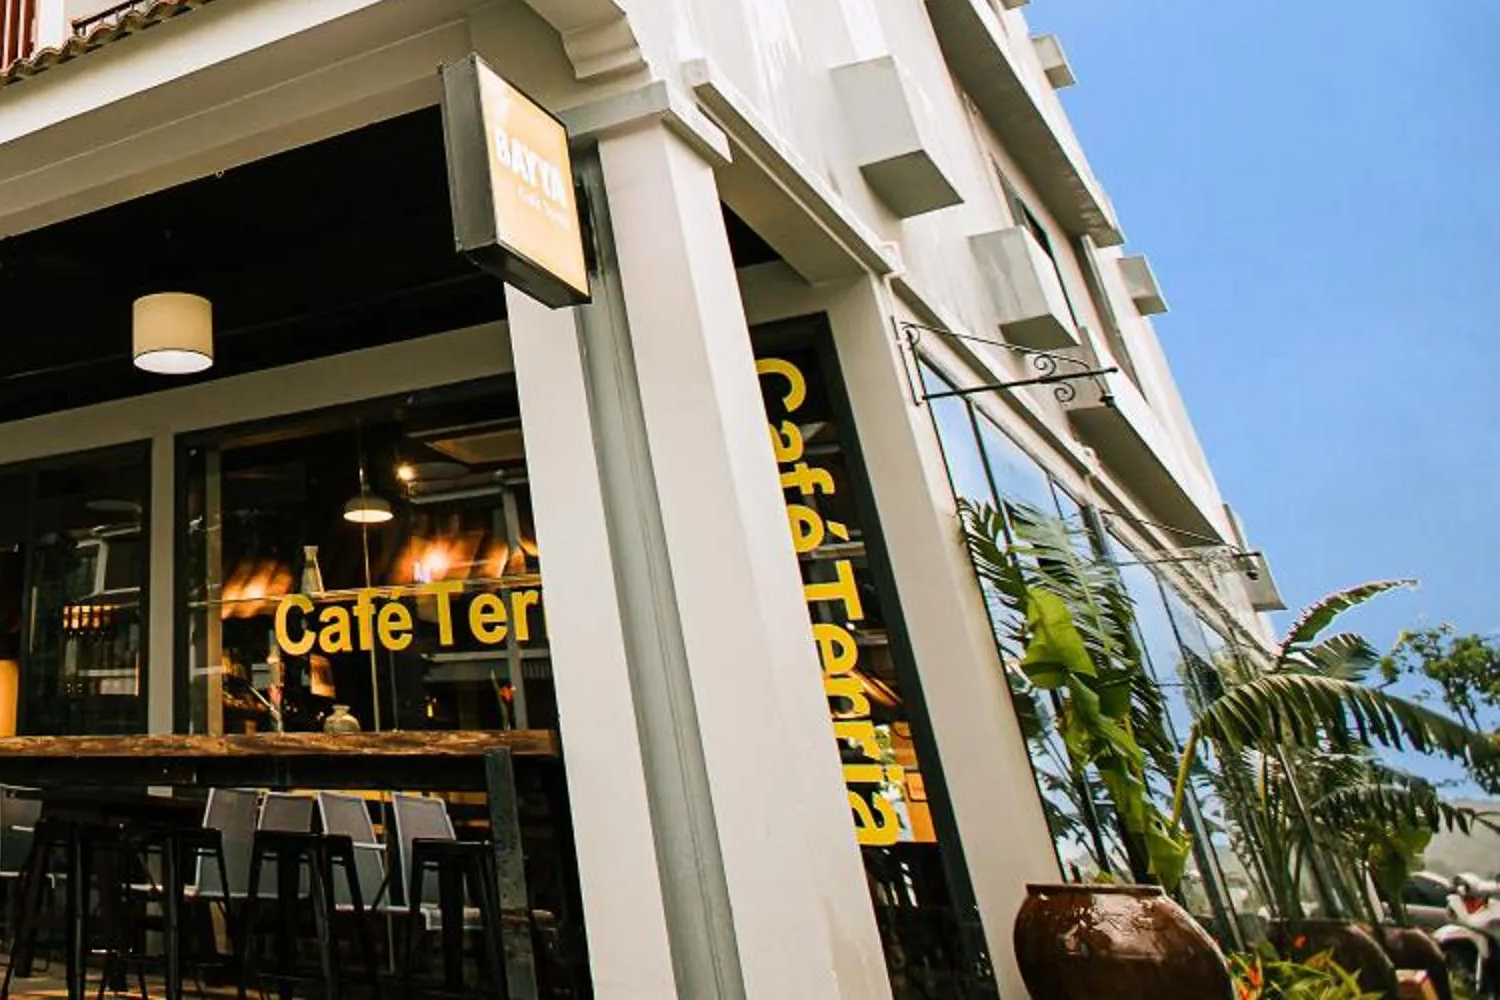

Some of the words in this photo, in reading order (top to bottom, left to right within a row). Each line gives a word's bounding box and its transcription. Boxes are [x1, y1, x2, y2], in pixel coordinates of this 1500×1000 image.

[756, 358, 849, 553] Café
[275, 588, 413, 655] Café
[425, 582, 538, 646] Ter
